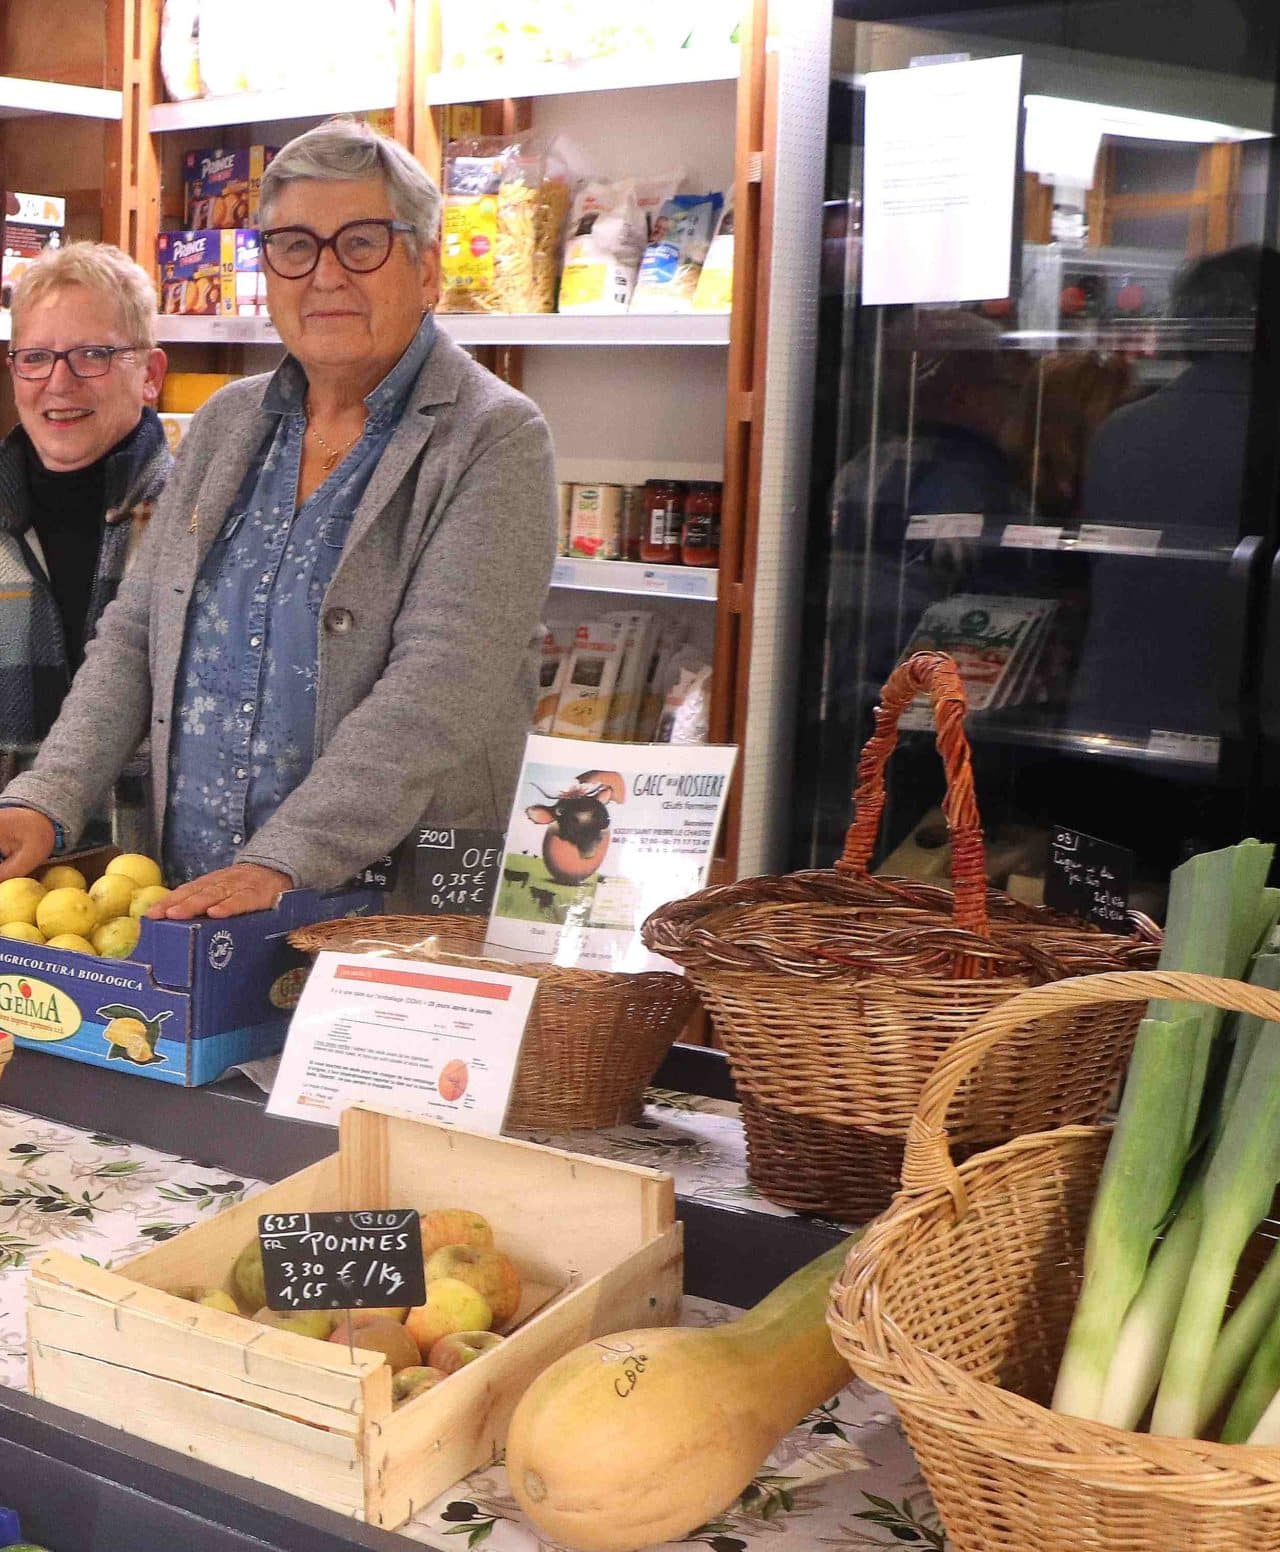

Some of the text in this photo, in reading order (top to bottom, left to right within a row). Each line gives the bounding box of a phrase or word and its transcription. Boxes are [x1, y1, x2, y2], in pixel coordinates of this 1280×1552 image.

[201, 153, 236, 179] PRINCE
[173, 237, 207, 262] PRINCE
[222, 263, 233, 273] 10
[632, 773, 667, 797] GAEC
[419, 829, 449, 844] 700
[431, 871, 486, 892] 0,35 €
[431, 888, 484, 908] 0,18 €
[77, 969, 143, 991] BIOLOGICA
[264, 1211, 398, 1232] 625 BIO
[263, 1231, 409, 1256] FR POMMES
[280, 1261, 325, 1283] 3,30
[336, 1261, 357, 1280] €
[278, 1282, 328, 1306] 1,65
